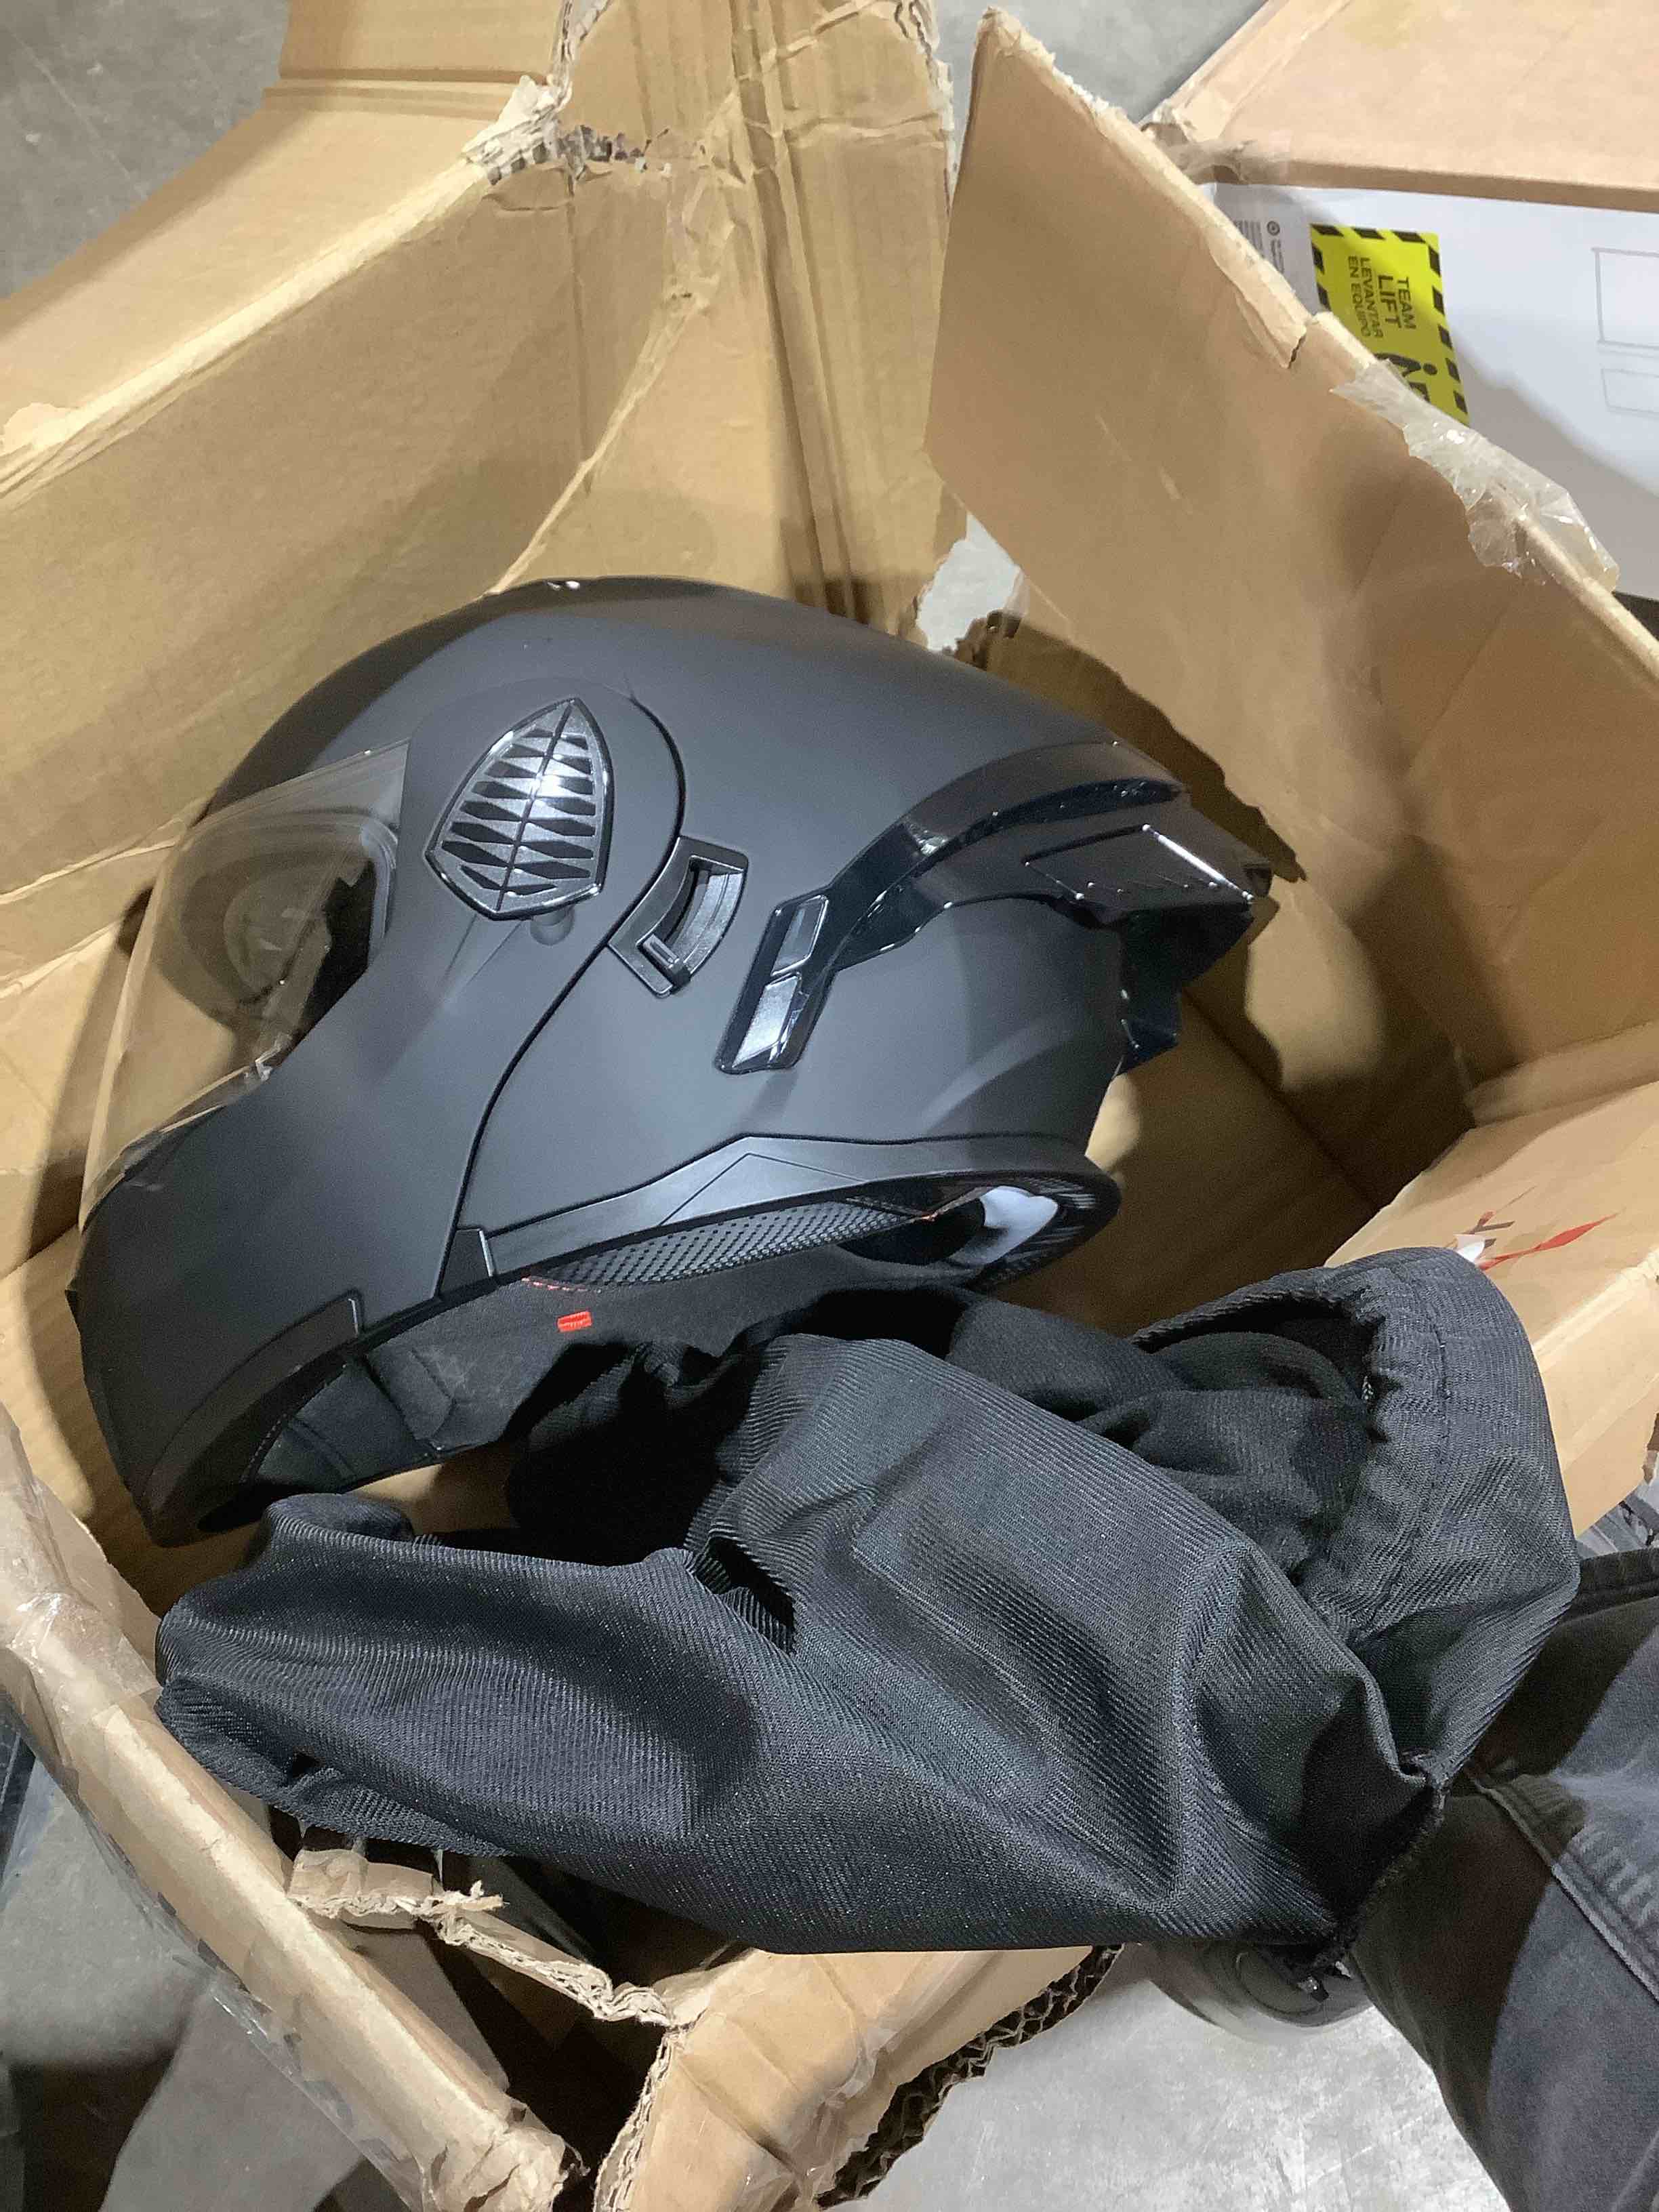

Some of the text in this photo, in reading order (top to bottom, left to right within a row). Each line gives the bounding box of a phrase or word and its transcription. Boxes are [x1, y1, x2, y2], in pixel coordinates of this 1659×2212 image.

[1348, 255, 1371, 337] EN EQUIPO
[1360, 257, 1384, 337] LEVANTAR
[1378, 274, 1401, 329] LIFT
[1397, 276, 1416, 329] TEAM
